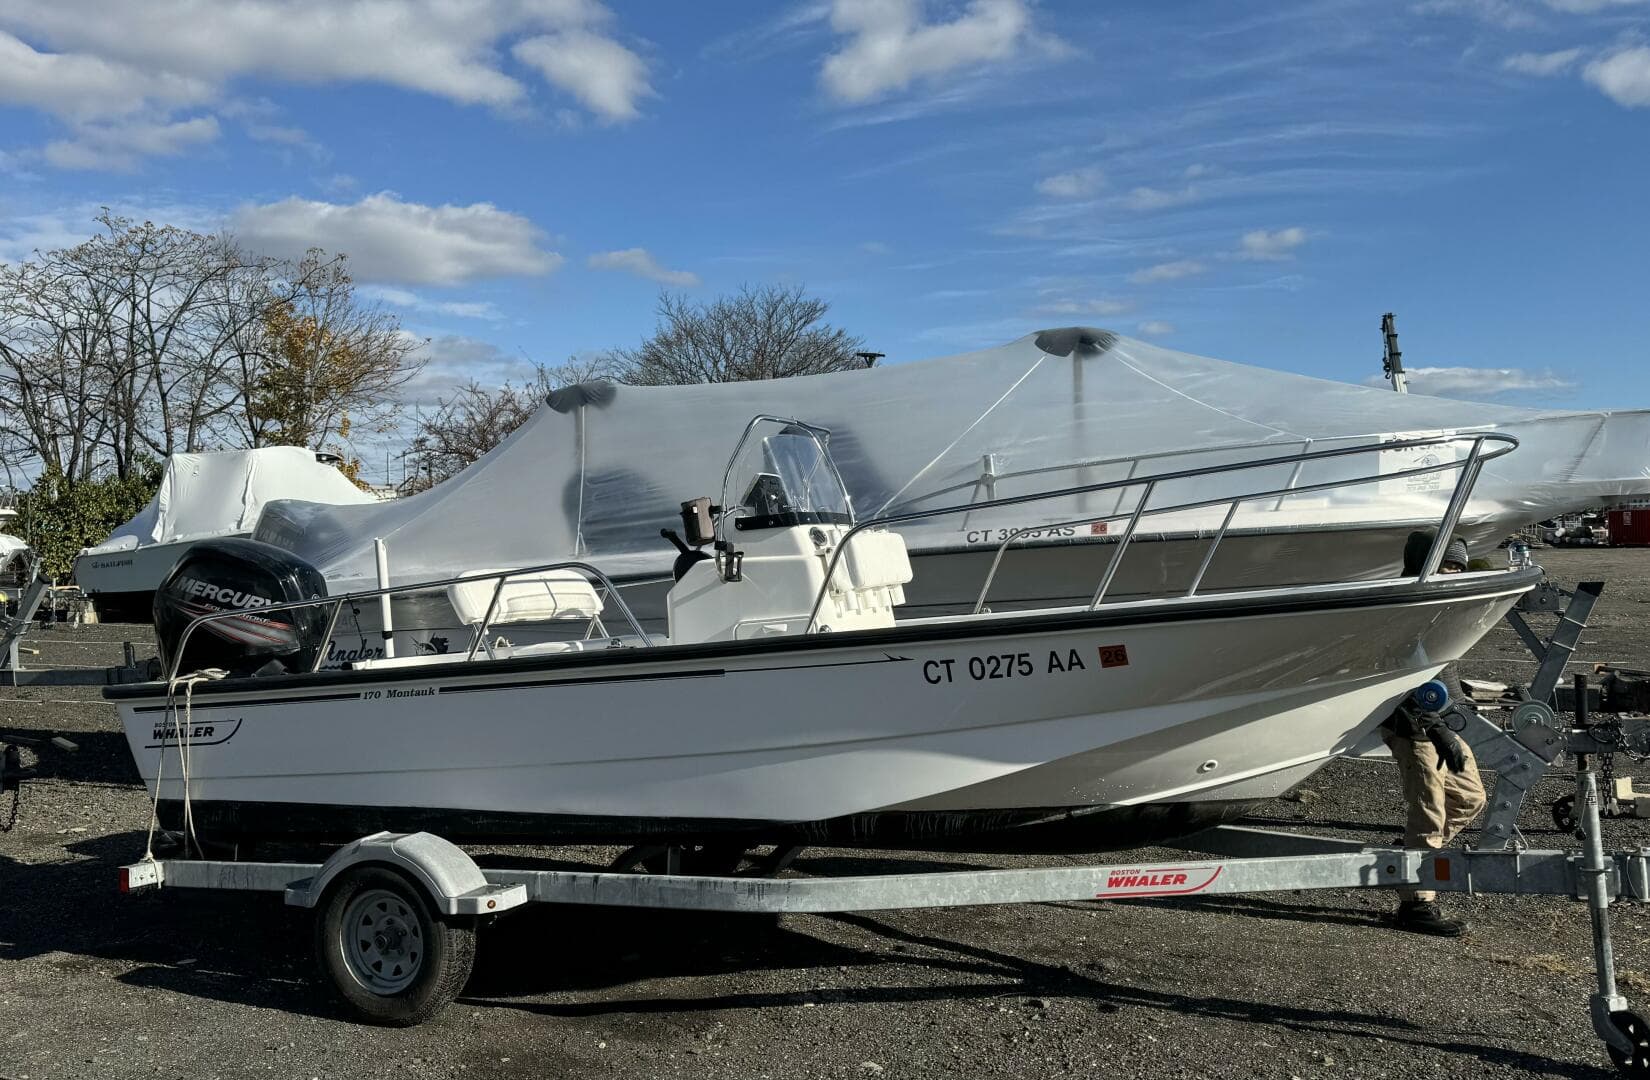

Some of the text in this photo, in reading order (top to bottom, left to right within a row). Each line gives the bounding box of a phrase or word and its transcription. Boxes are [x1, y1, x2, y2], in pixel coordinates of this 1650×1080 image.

[966, 529, 993, 544] CT
[1047, 525, 1076, 538] AS
[1101, 648, 1127, 664] 26
[922, 648, 1086, 685] CT 0275 AA
[363, 686, 436, 700] 170 Montauk
[1110, 868, 1142, 876] BOSTON
[1107, 873, 1188, 888] WHALER
